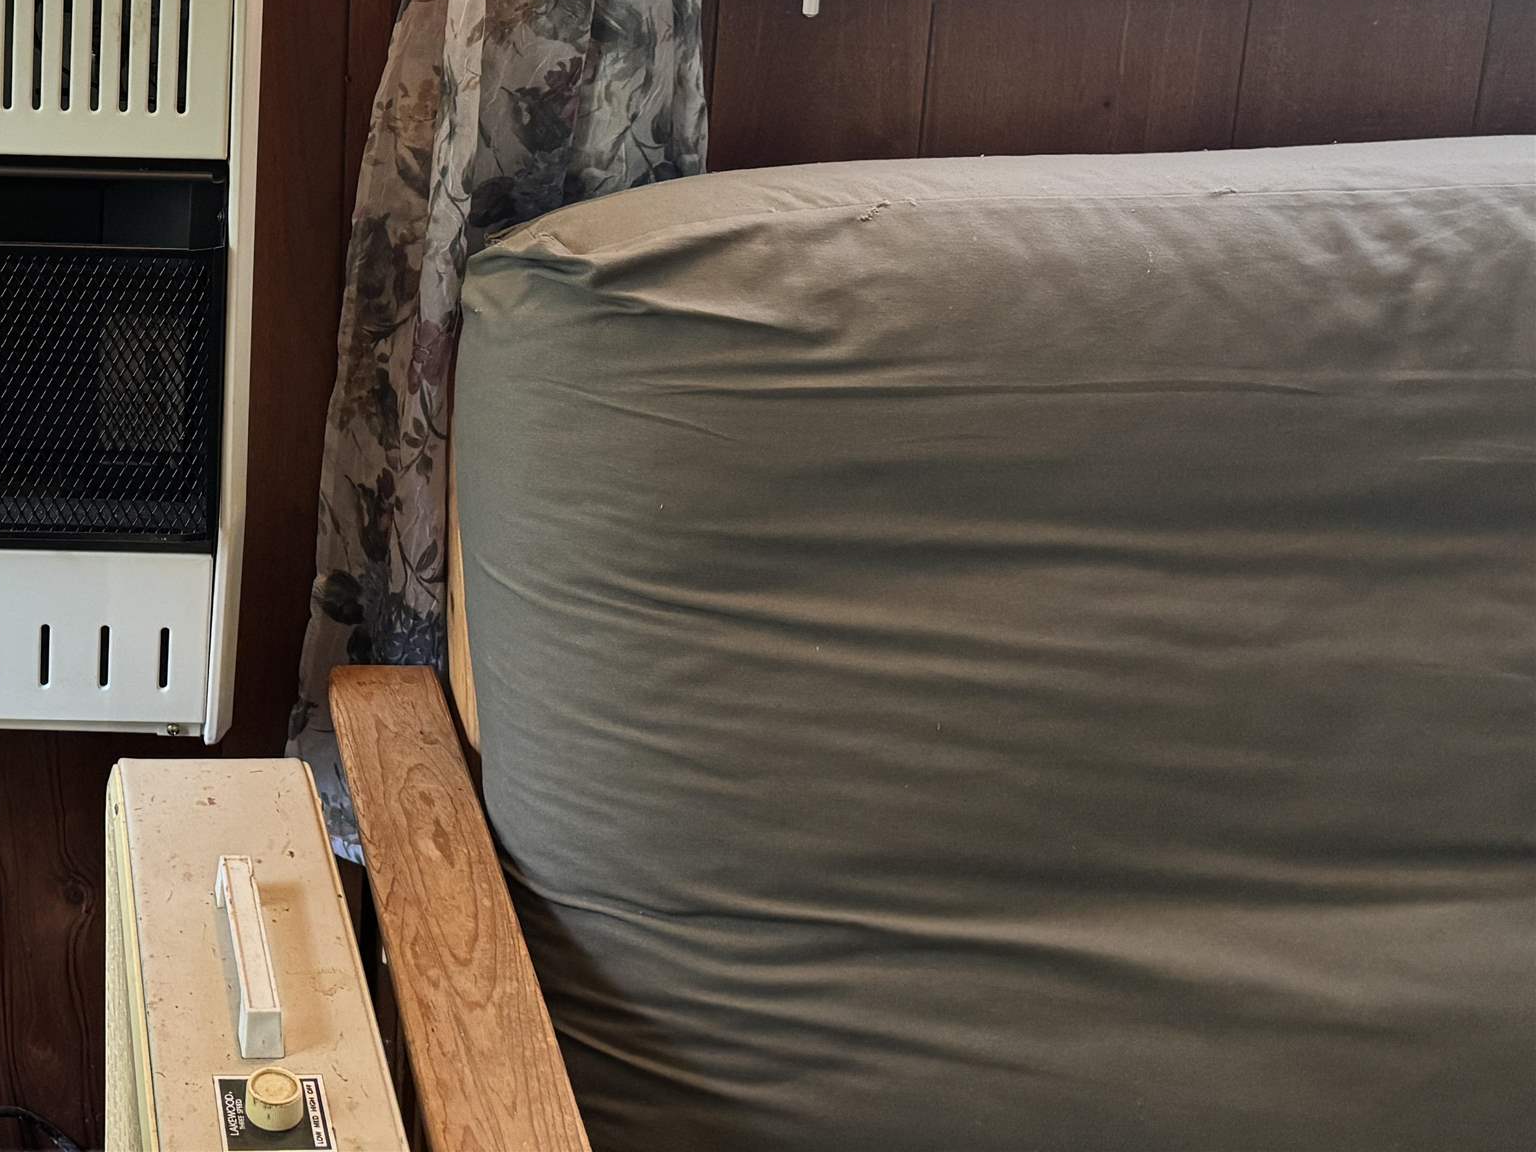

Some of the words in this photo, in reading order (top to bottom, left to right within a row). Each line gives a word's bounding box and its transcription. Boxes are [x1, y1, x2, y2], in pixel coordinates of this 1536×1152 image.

[305, 1083, 314, 1095] OFF
[235, 1098, 244, 1113] SPEED
[308, 1096, 318, 1112] HIGH
[224, 1093, 241, 1137] LAKEWOOD
[311, 1115, 321, 1129] MED
[314, 1131, 325, 1145] LOW
